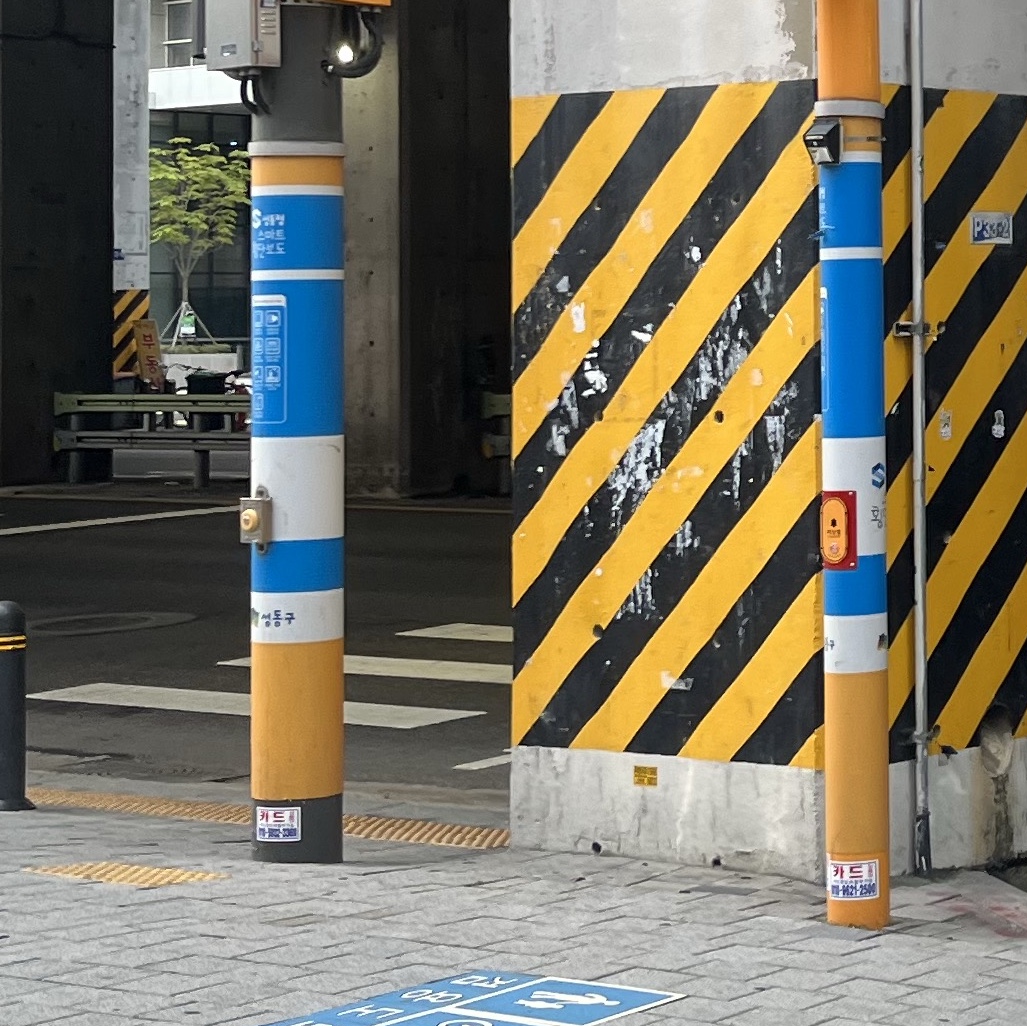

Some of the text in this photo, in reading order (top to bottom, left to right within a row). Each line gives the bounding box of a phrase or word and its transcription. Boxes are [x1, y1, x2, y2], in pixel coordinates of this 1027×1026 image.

[261, 609, 295, 628] 성동구
[260, 810, 285, 823] 카드
[833, 864, 863, 879] 카드
